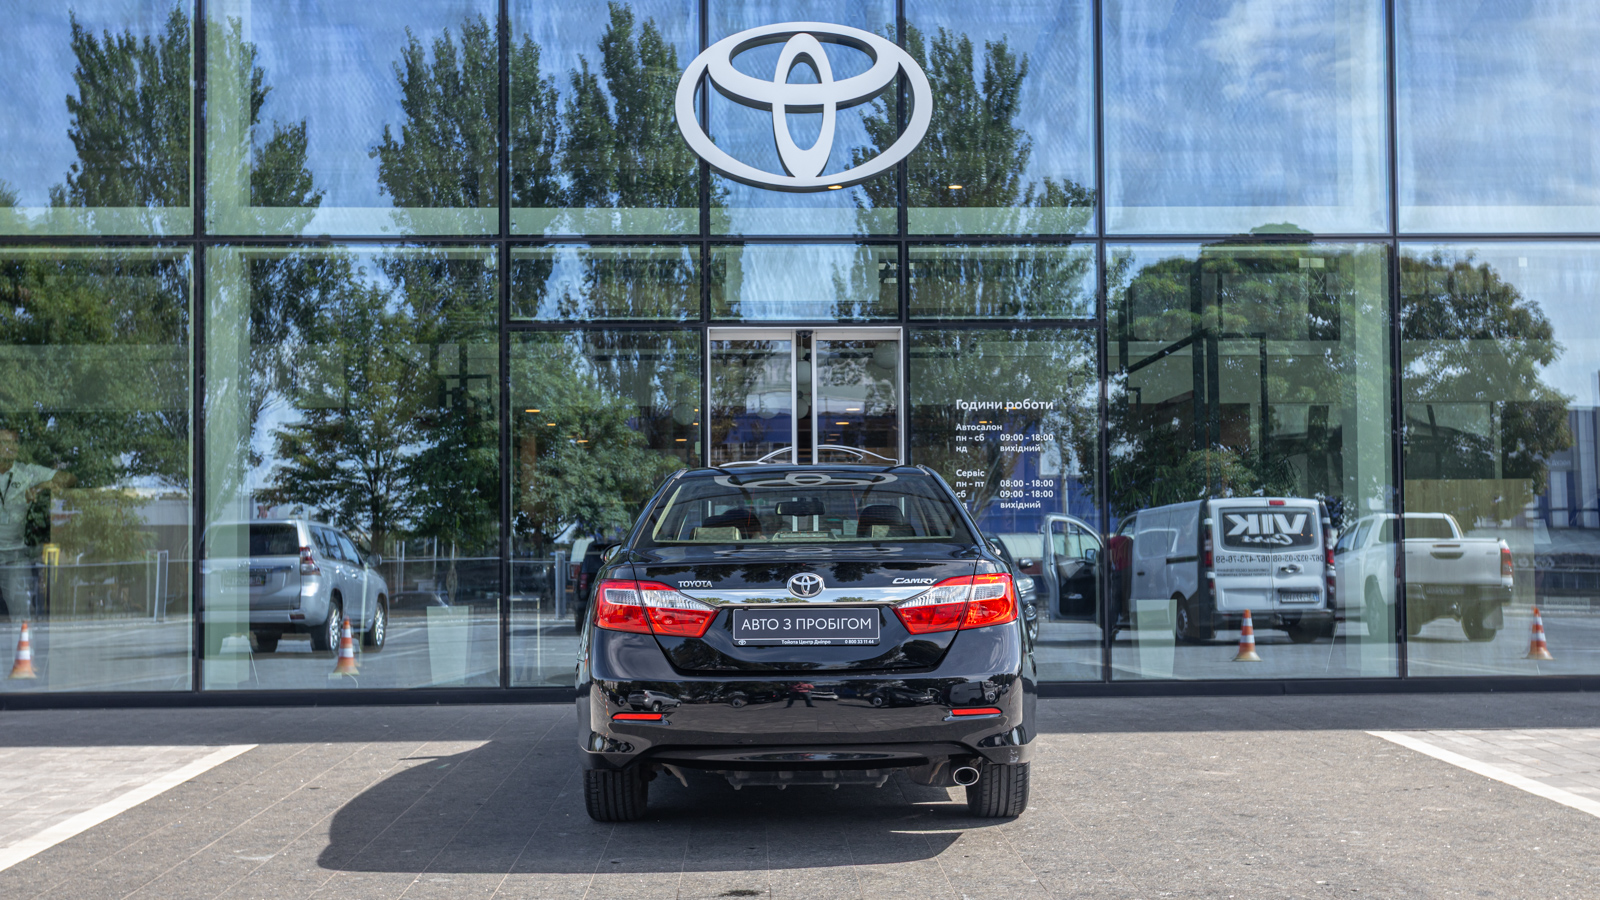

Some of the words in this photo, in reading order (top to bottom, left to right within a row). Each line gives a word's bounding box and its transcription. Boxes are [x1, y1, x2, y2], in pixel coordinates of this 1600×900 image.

[956, 399, 1003, 412] Години
[1006, 398, 1054, 412] роботи
[955, 423, 1003, 431] Автосалон
[956, 434, 967, 442] пн
[974, 433, 985, 442] сб
[1000, 433, 1024, 442] 09:00
[1031, 433, 1054, 442] 18:00
[956, 445, 968, 453] нд
[1000, 443, 1041, 453] вихідний
[956, 469, 985, 478] Сервіс
[1000, 480, 1024, 488] 08:00
[1031, 480, 1054, 488] 18:00
[956, 490, 967, 498] сб
[1000, 490, 1024, 498] 09:00
[1031, 490, 1054, 498] 18:00
[1000, 500, 1041, 510] вихідний
[678, 580, 713, 588] TOYOTA
[741, 619, 779, 630] АВТО
[796, 618, 872, 630] ПРОБІГОМ
